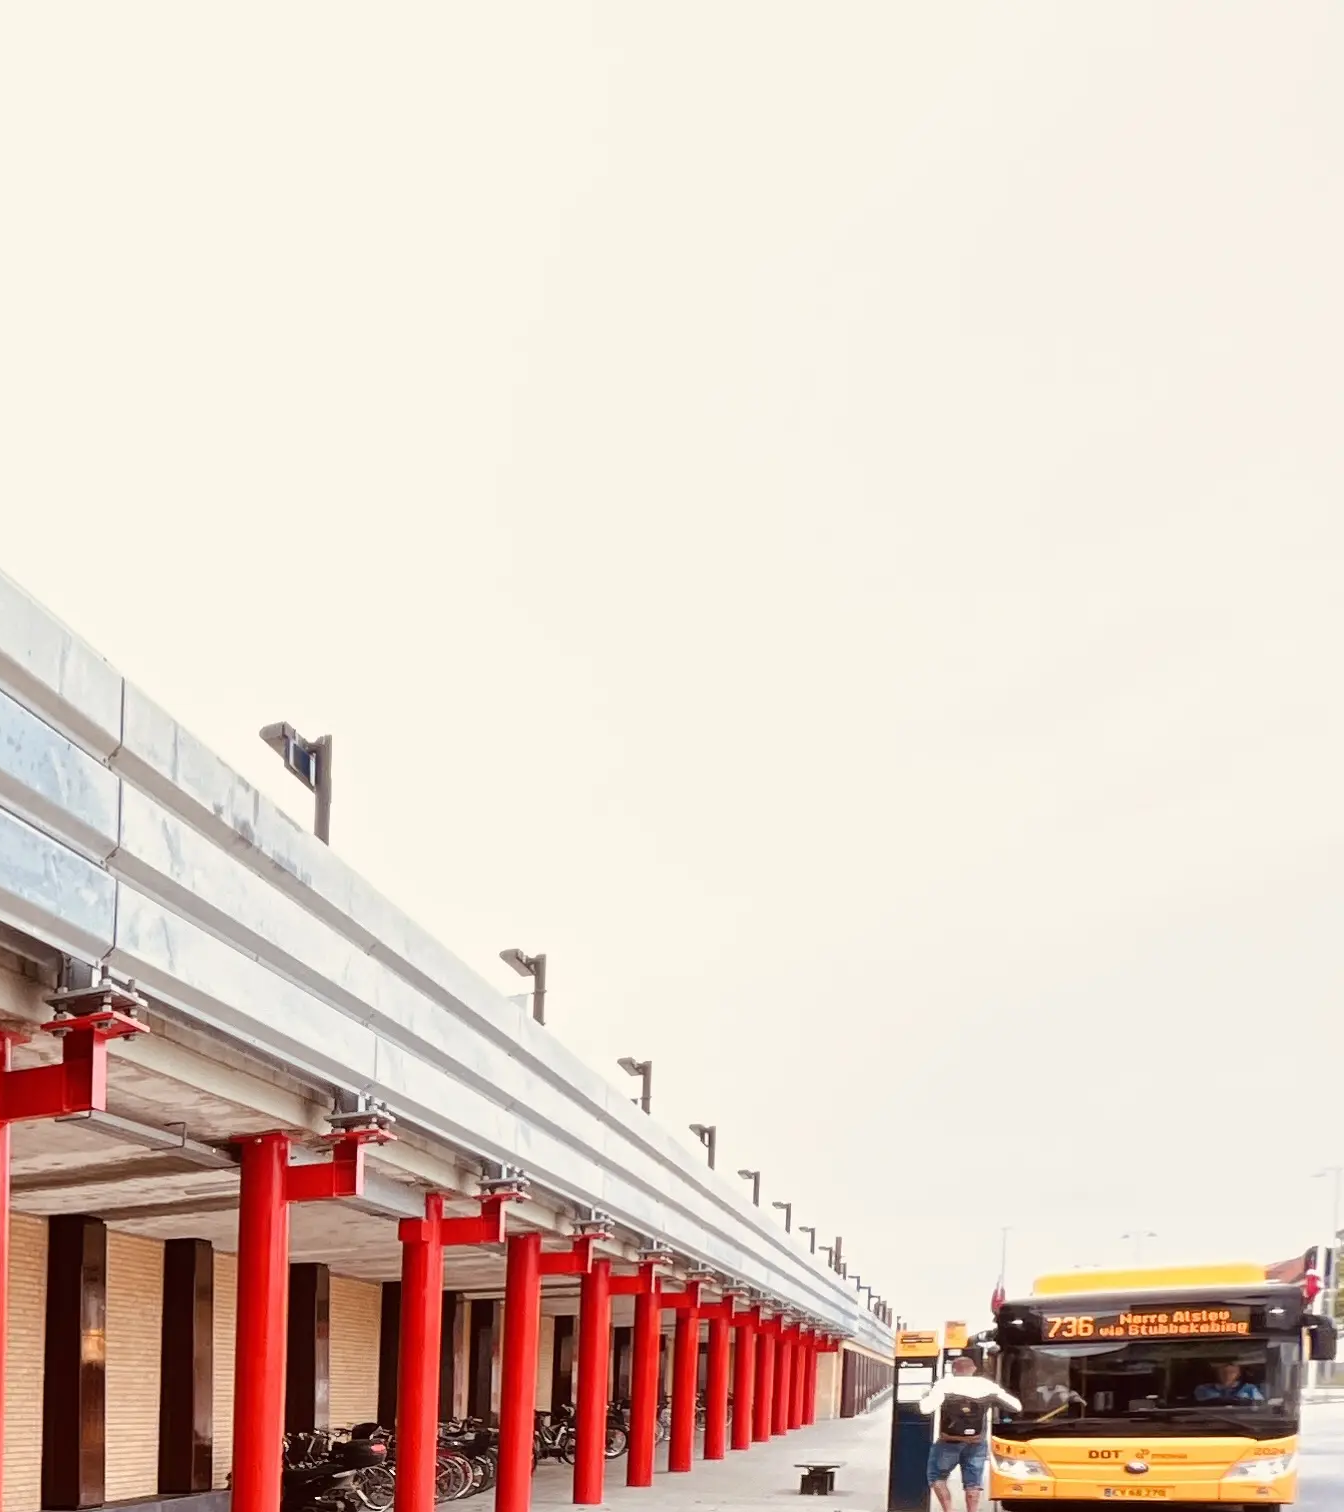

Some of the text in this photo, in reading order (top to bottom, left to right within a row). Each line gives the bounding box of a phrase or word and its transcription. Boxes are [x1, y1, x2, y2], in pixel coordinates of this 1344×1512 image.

[1173, 1310, 1230, 1323] Alslev
[1046, 1316, 1095, 1338] 736
[1088, 1450, 1123, 1459] DOT
